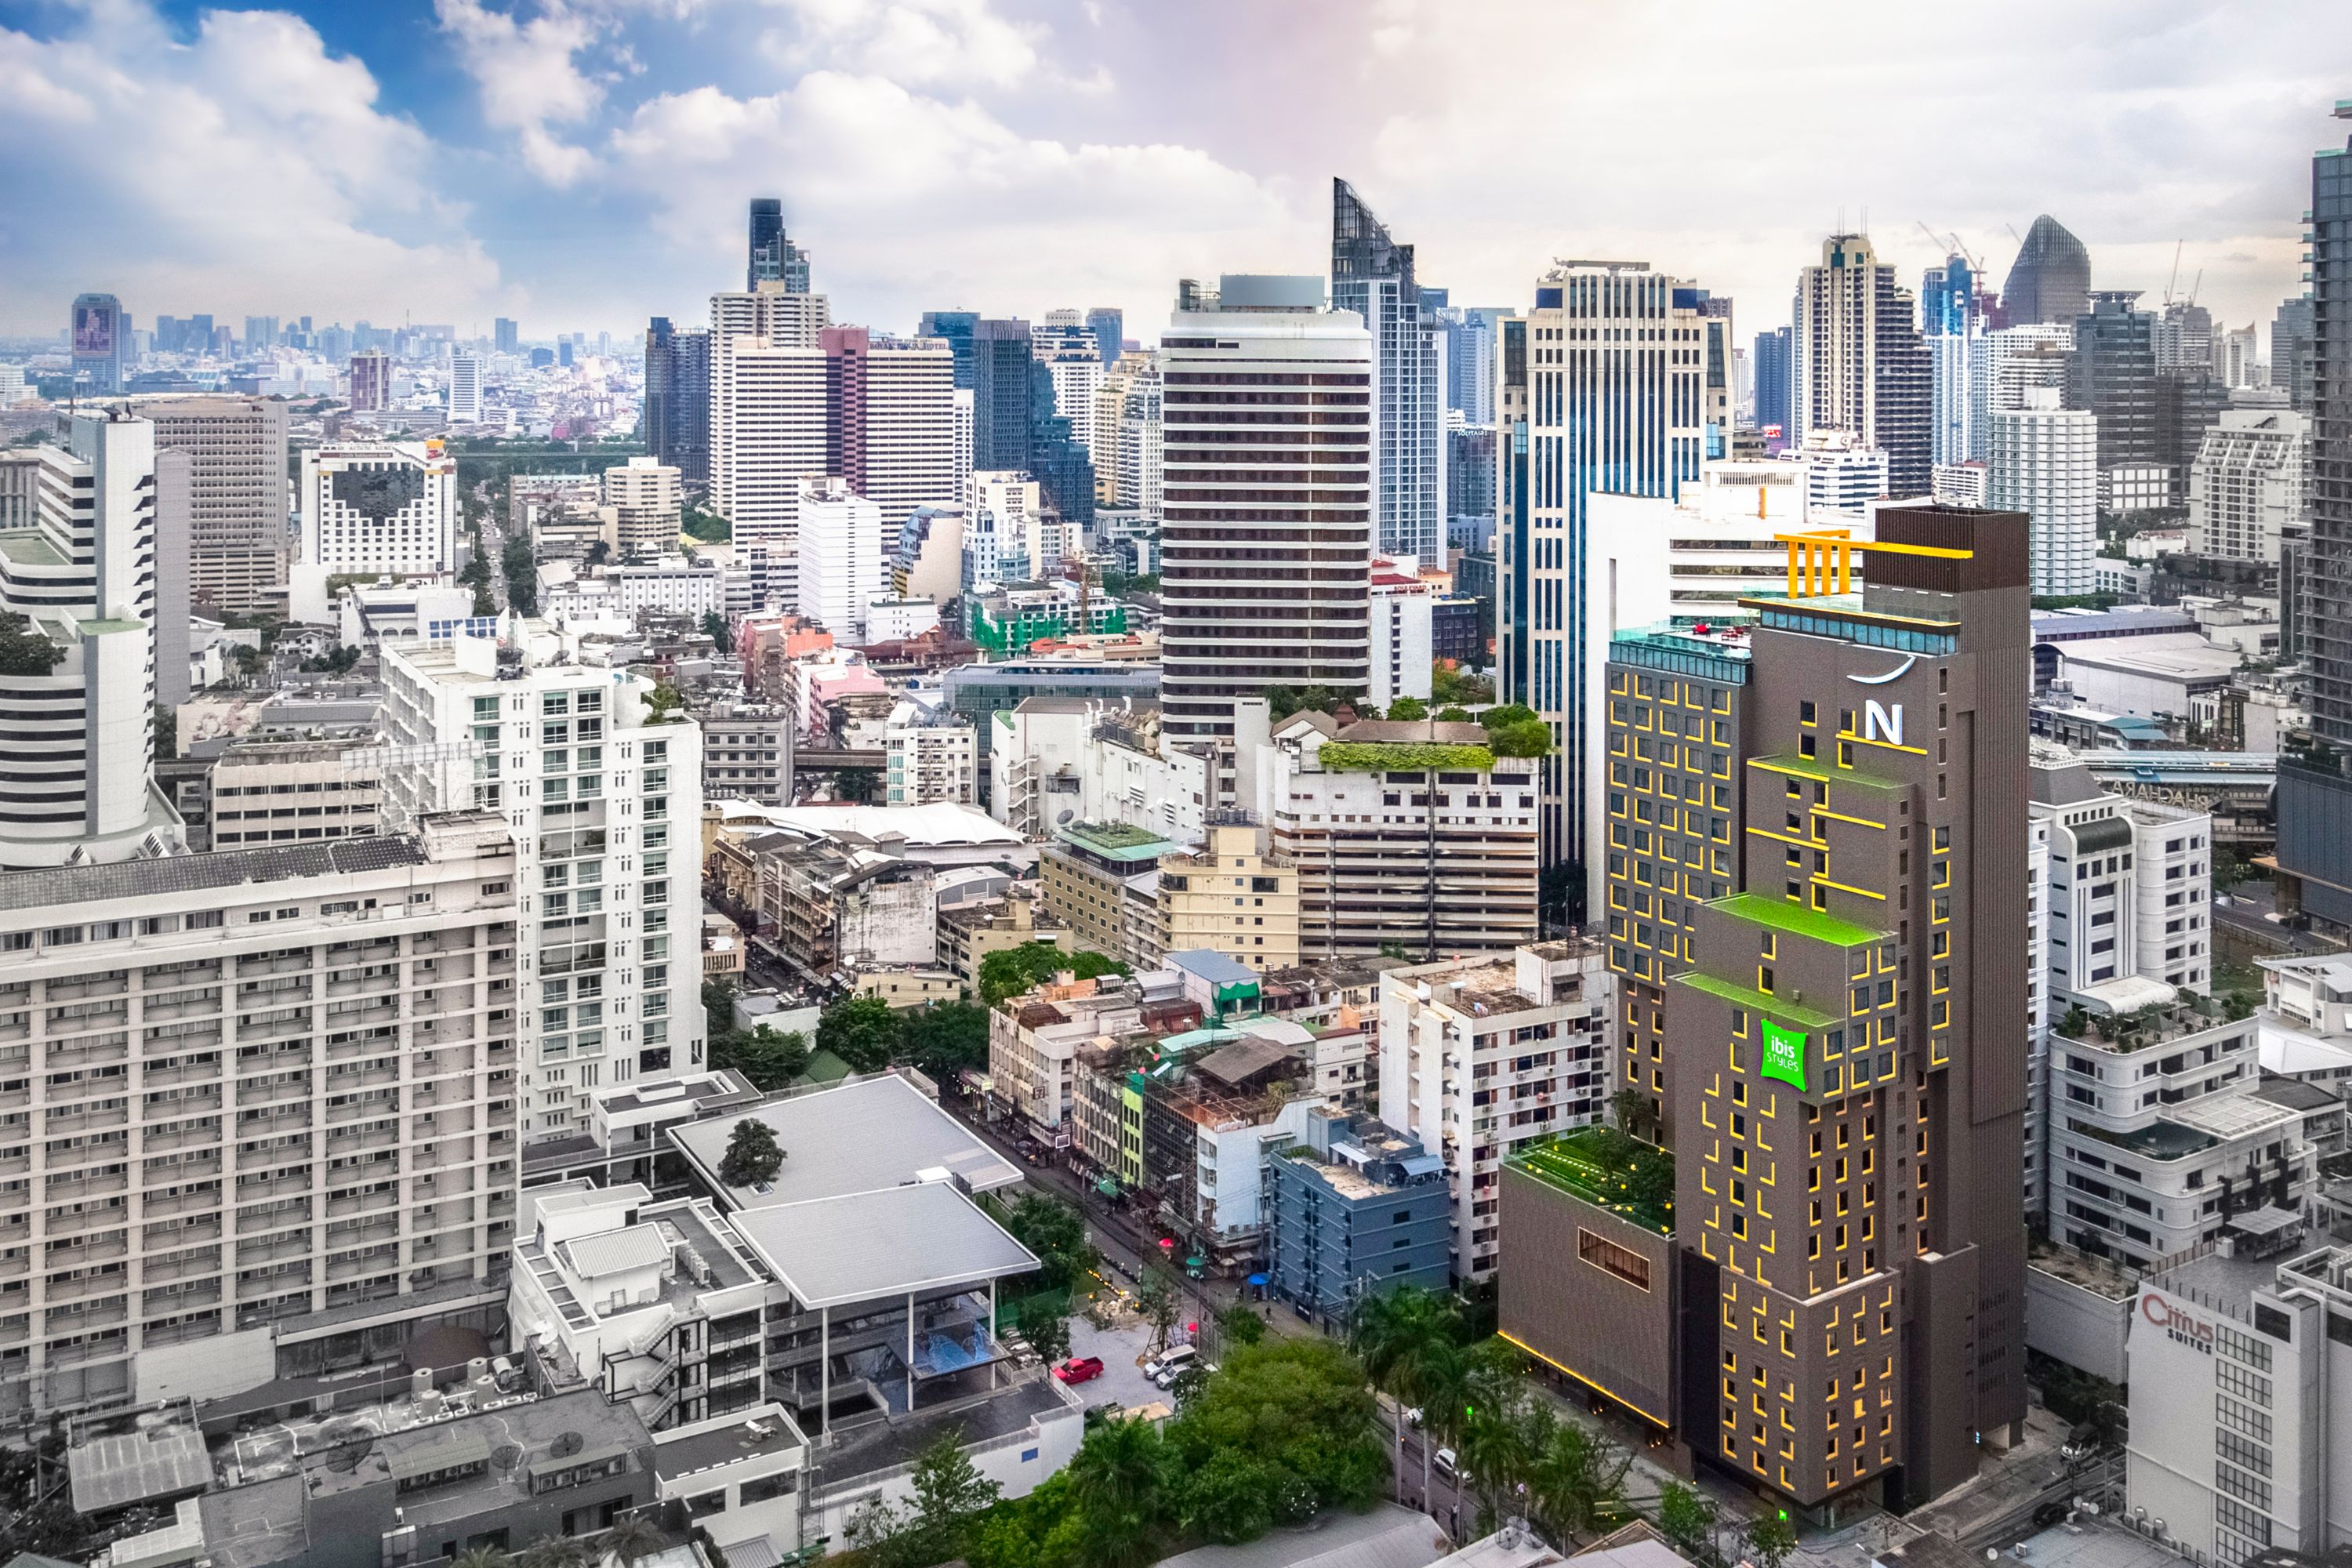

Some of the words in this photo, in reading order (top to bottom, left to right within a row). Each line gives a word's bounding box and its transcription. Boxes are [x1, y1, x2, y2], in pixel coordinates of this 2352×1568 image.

[1865, 699, 1903, 746] N
[1771, 1035, 1795, 1059] ibis
[2142, 1294, 2214, 1343] Citrus
[2168, 1328, 2212, 1355] SUITES
